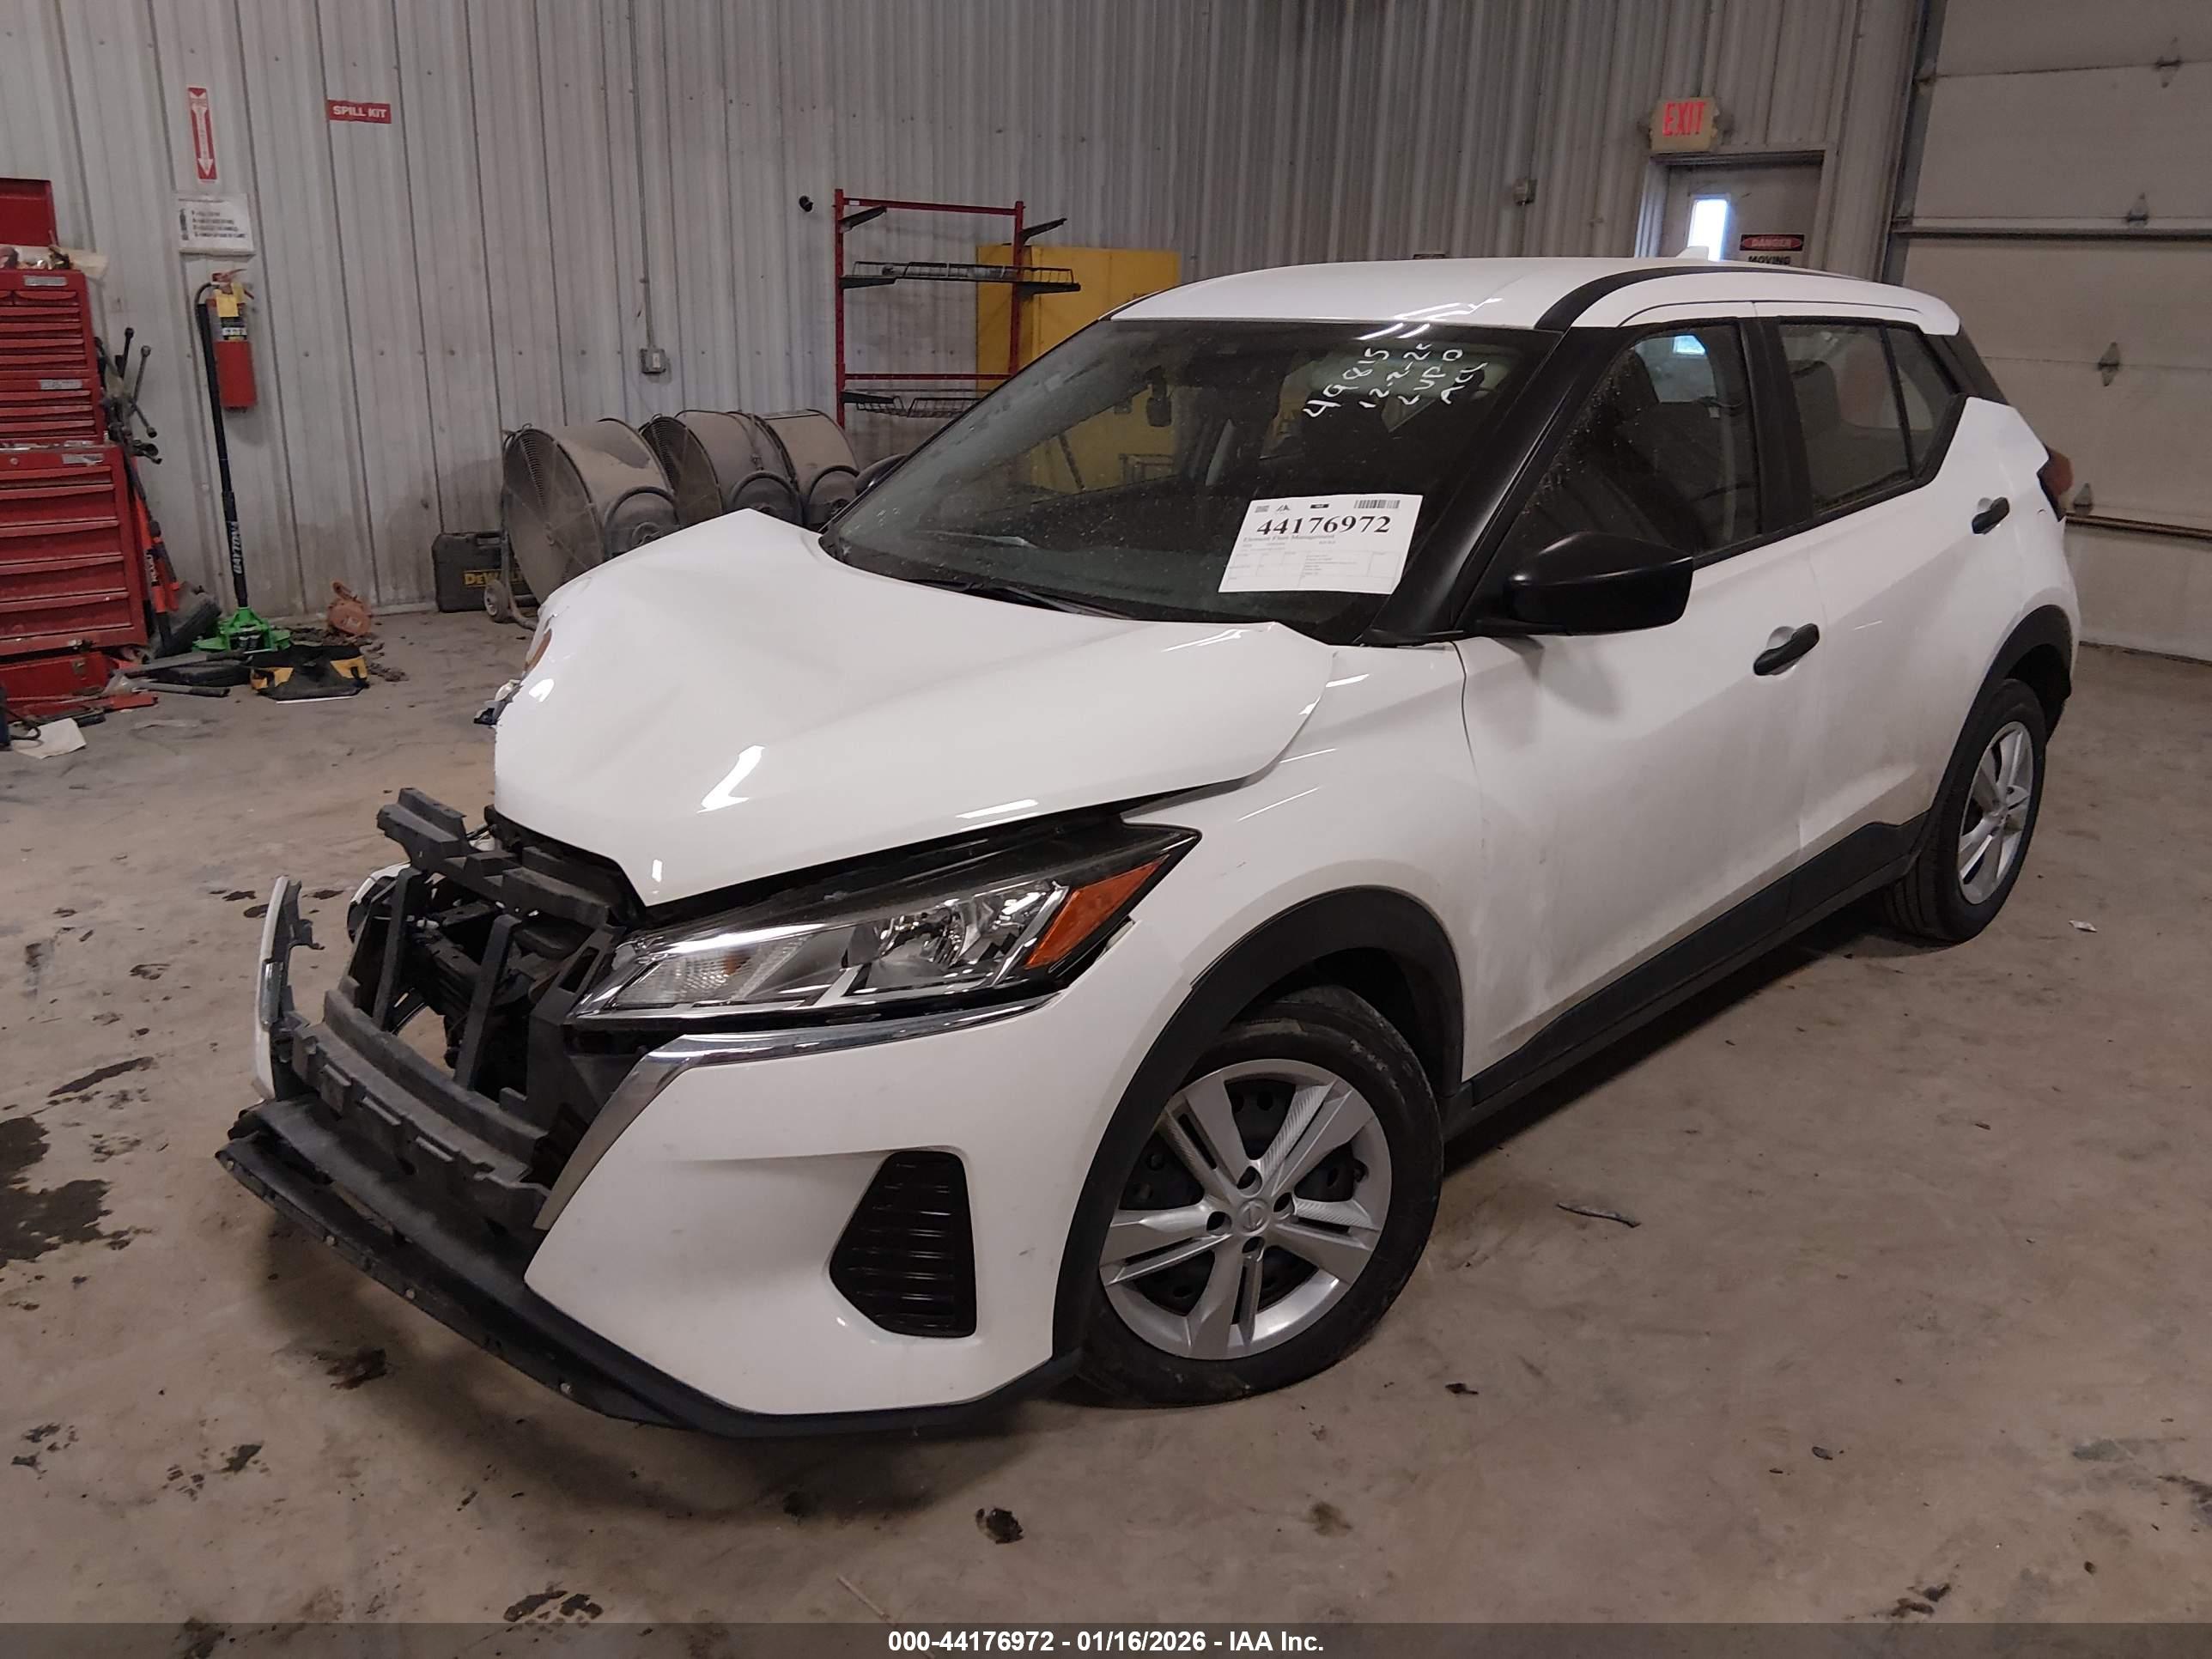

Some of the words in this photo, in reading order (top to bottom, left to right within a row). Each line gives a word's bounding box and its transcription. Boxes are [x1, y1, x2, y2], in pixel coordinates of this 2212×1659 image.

[332, 105, 367, 117] SPILL
[368, 107, 387, 118] KIT
[1662, 101, 1705, 137] EXIT
[1751, 238, 1791, 248] DANGER
[1747, 255, 1791, 265] MOVING
[1256, 515, 1391, 535] 44176972
